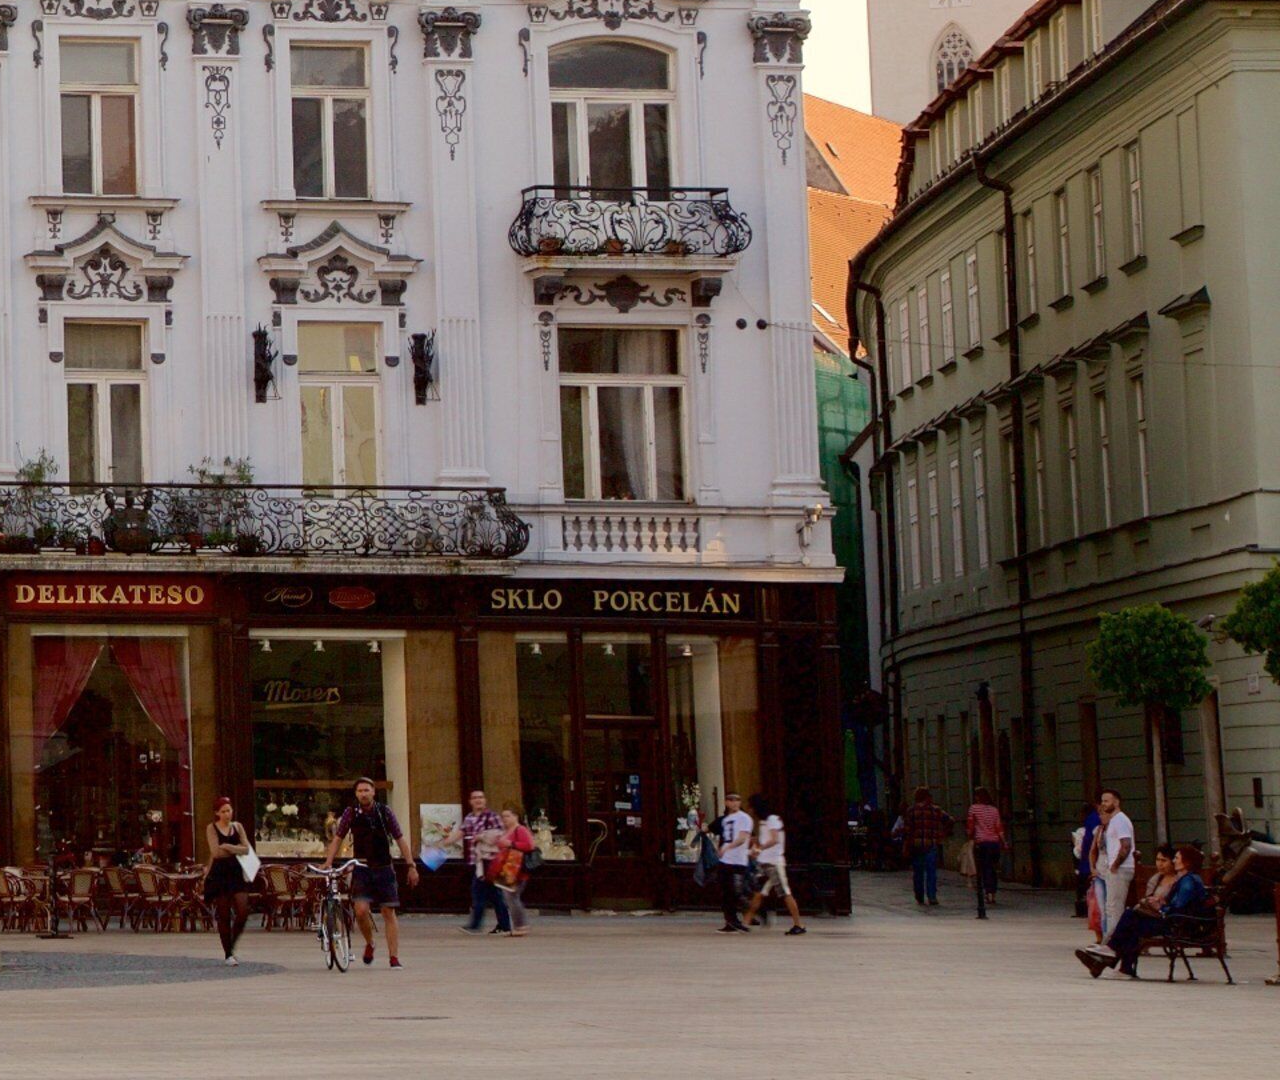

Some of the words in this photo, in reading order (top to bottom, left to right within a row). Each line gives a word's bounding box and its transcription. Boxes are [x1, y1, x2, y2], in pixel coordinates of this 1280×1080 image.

[15, 584, 205, 605] DELIKATESO
[491, 588, 563, 610] SKLO
[593, 588, 741, 614] PORCELÁN
